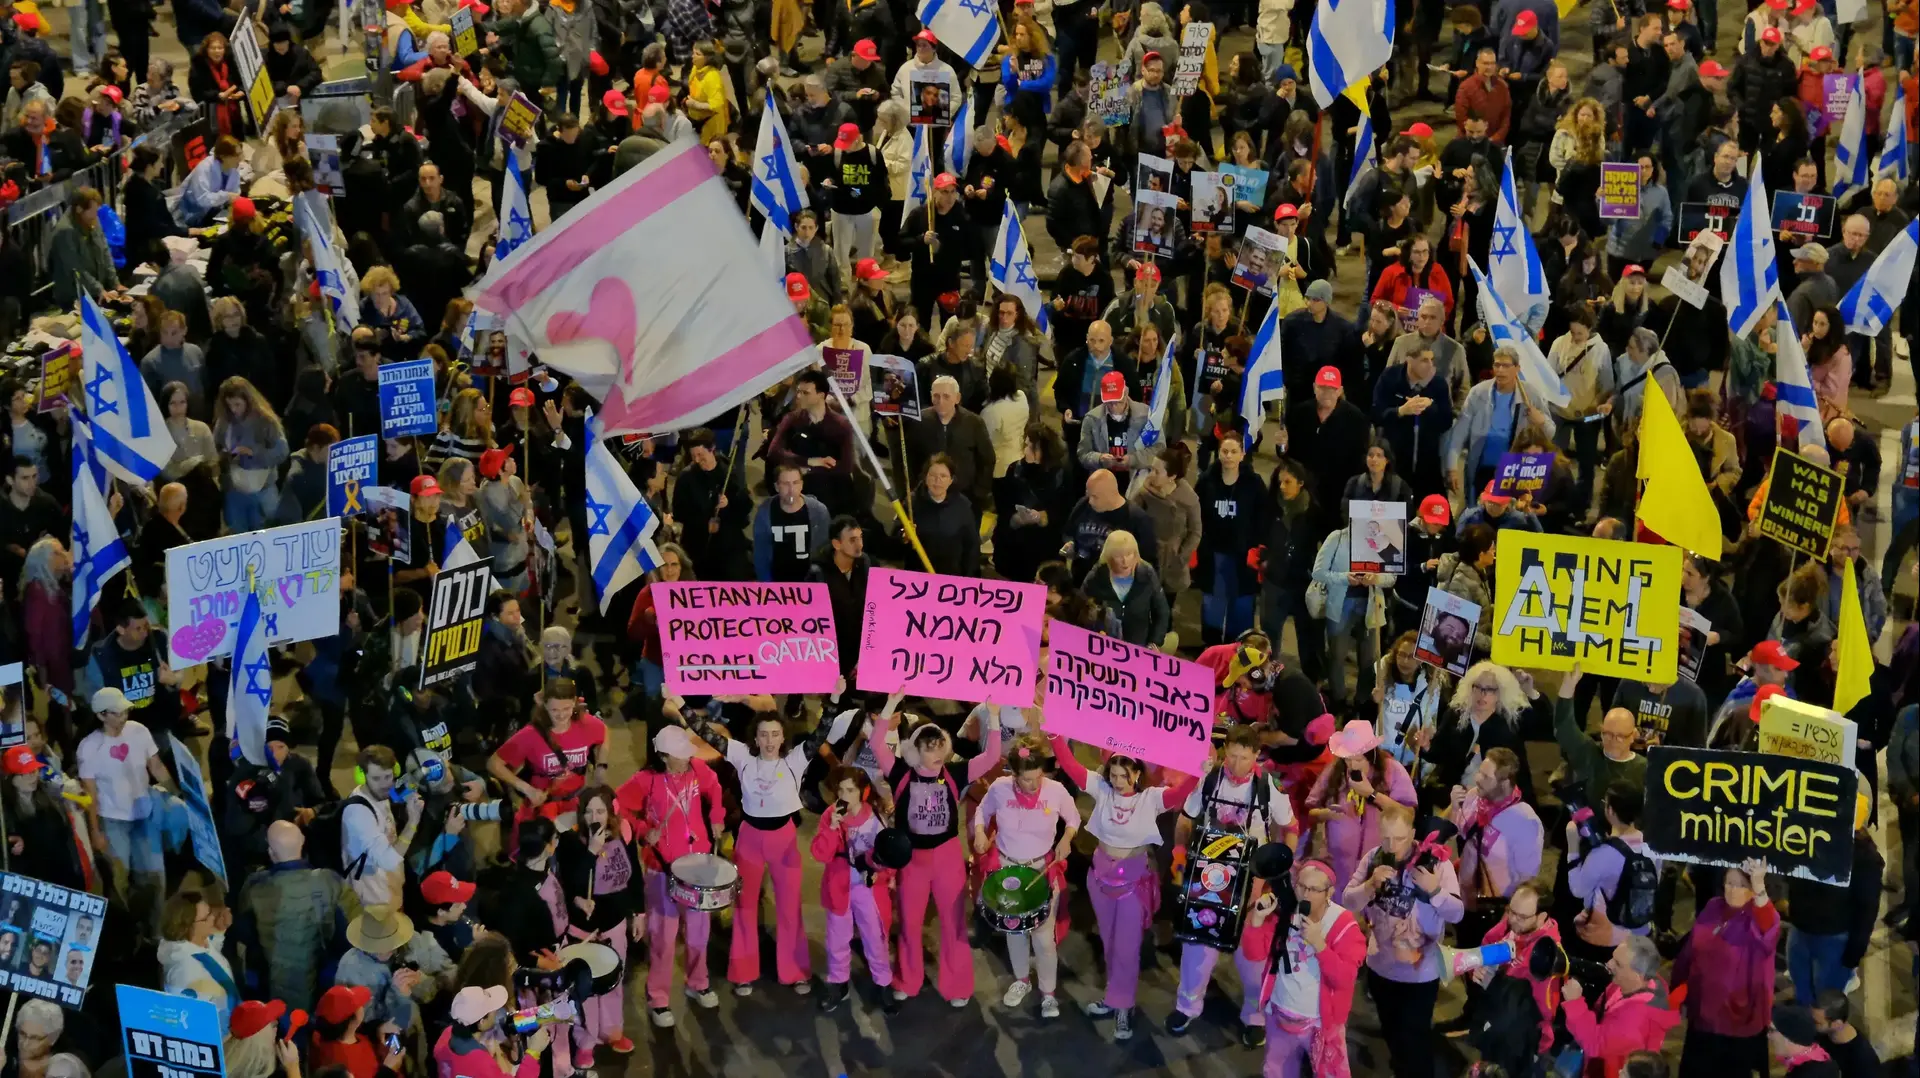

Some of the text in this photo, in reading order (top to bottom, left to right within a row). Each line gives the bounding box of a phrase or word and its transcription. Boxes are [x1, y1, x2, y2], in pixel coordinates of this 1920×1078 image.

[842, 163, 871, 175] SEAL
[842, 174, 870, 185] DEAL
[1796, 202, 1816, 223] כל
[384, 413, 433, 429] ממלכתית
[391, 402, 425, 416] חקירה
[1793, 463, 1831, 488] WAR
[1791, 477, 1829, 504] HAS
[1769, 500, 1831, 539] WINNERS
[1795, 498, 1819, 517] NO
[187, 528, 336, 592] עוד מעט
[433, 566, 490, 629] כולם
[669, 586, 813, 609] NETANYAHU
[889, 575, 1023, 613] נפלתם על
[1497, 565, 1662, 652] ALL
[1518, 589, 1634, 628] THEM
[669, 617, 831, 641] PROTECTOR OF
[905, 609, 1002, 645] האמא
[427, 618, 483, 668] עכשיו!
[758, 637, 838, 666] QATAR
[122, 672, 154, 692] LAST
[679, 653, 767, 682] ISRAEL
[891, 648, 1022, 687] הלא נכונה
[1055, 650, 1210, 713] כאבי העסקה
[1804, 723, 1839, 748] עכשיו
[1663, 759, 1840, 818] CRIME
[1680, 805, 1831, 858] minister
[2, 874, 104, 916] כולם כולל כולם
[10, 973, 59, 999] החטוף
[60, 985, 82, 1005] עד
[132, 1031, 215, 1069] כמה דם
